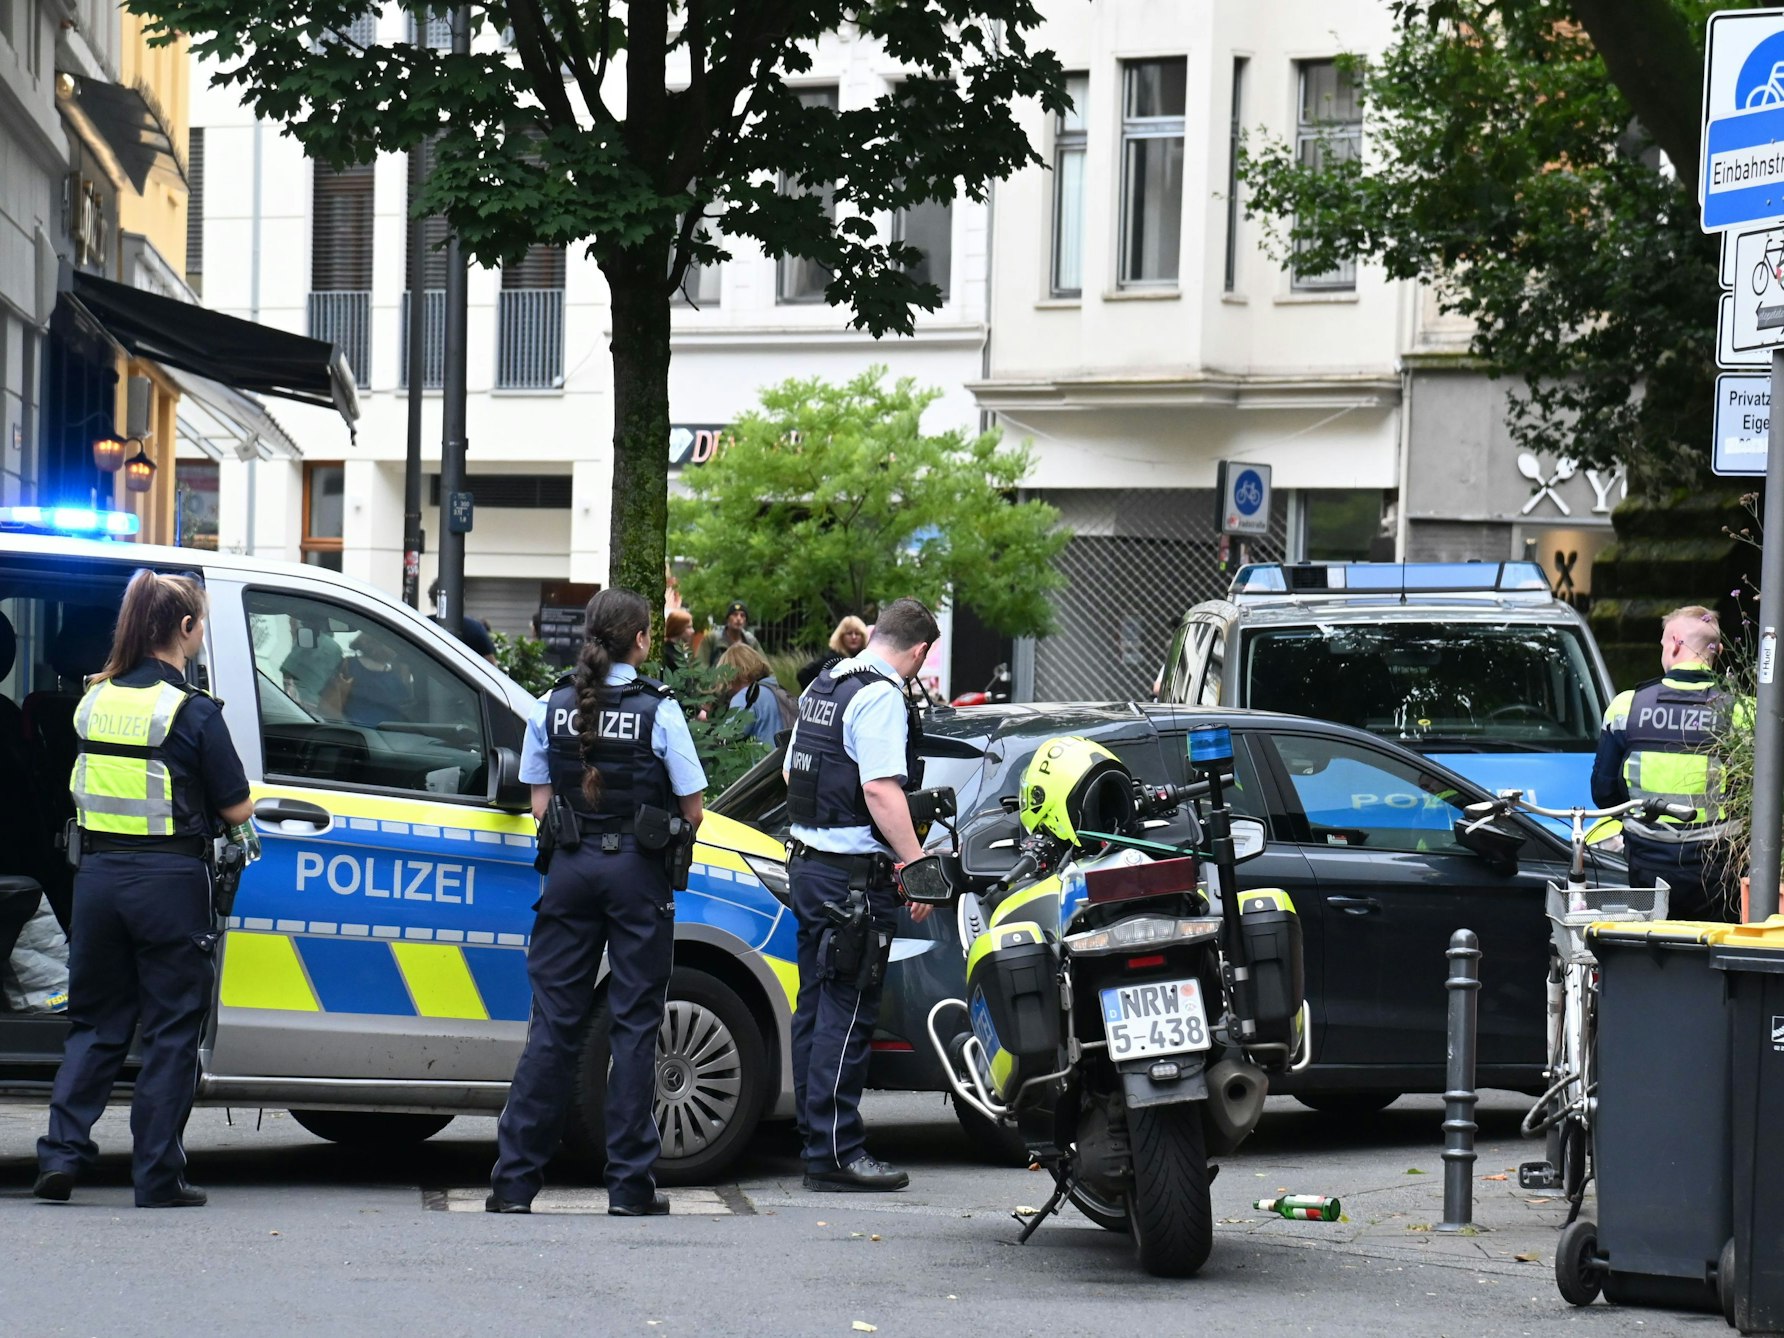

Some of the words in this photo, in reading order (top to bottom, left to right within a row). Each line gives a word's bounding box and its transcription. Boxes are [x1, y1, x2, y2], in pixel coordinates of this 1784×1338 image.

[89, 712, 149, 737] POLIZEI
[553, 708, 641, 740] POIZEI
[1638, 707, 1718, 732] POLIZEI
[296, 851, 476, 905] POLIZEI
[1109, 1009, 1118, 1019] D
[1120, 984, 1179, 1019] NRW
[1111, 1016, 1204, 1053] 5-438
